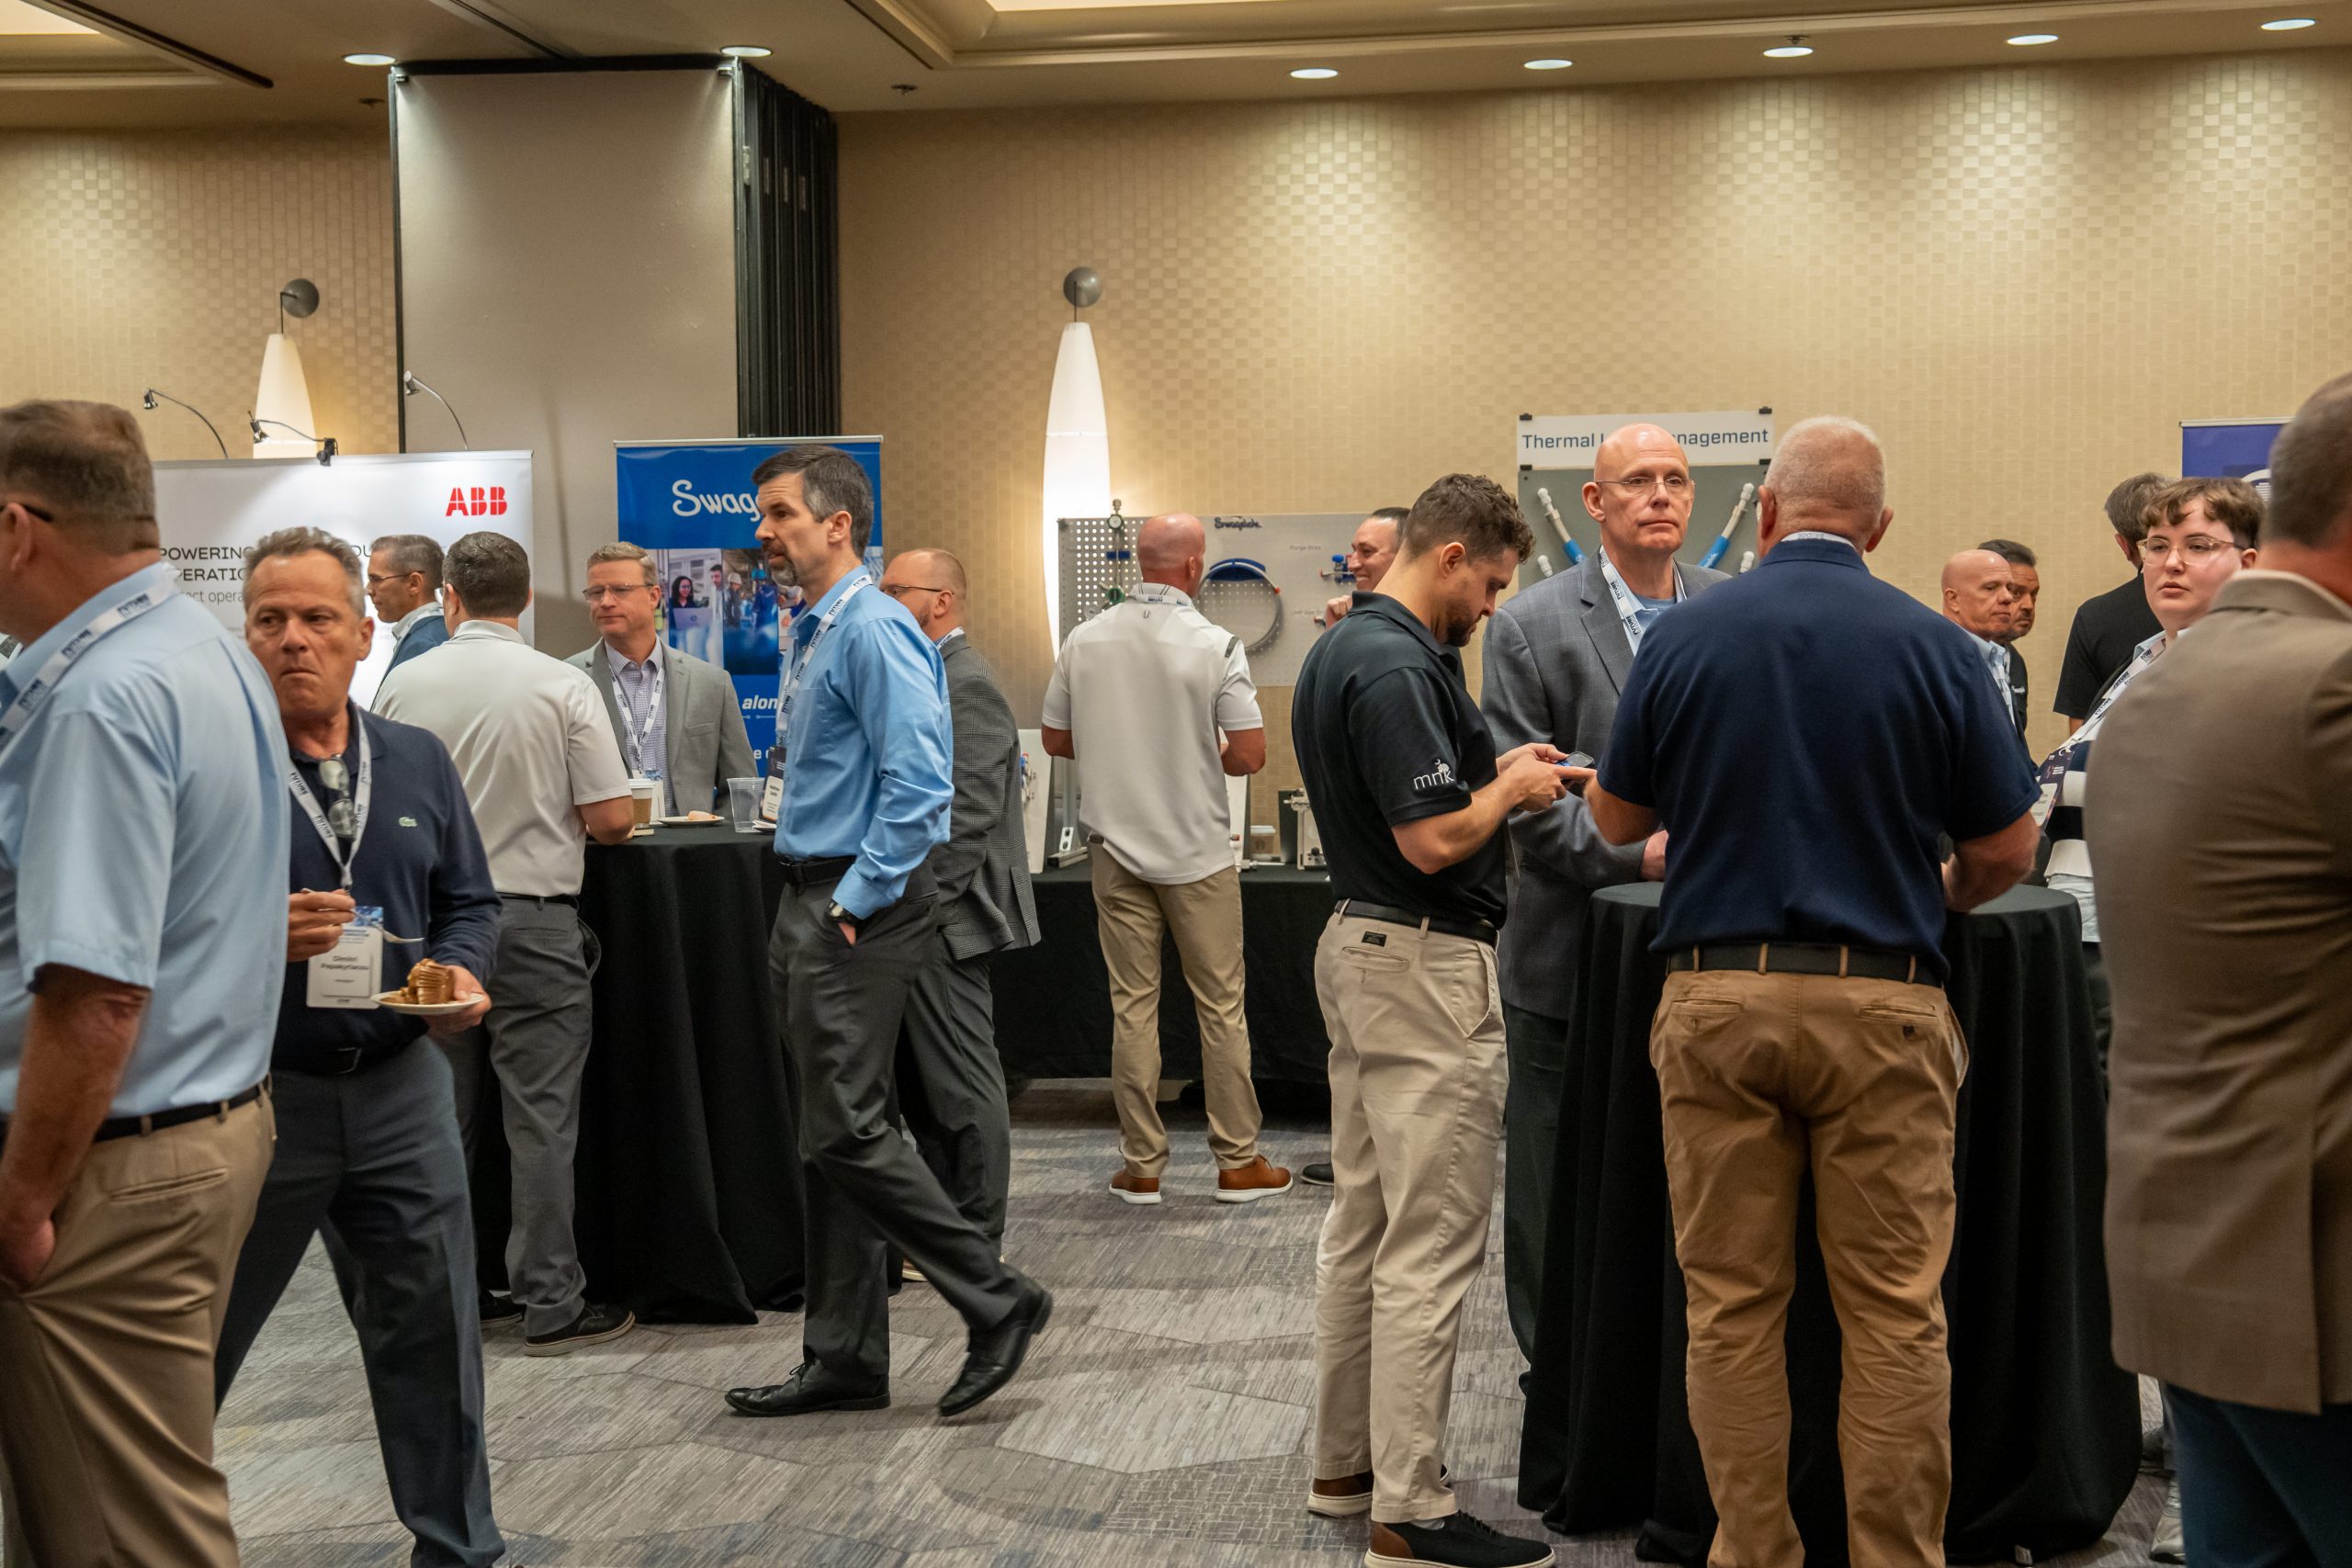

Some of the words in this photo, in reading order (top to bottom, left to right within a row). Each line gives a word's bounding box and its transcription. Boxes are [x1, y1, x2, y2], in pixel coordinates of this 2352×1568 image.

[1521, 433, 1595, 448] Thermal
[1672, 428, 1769, 447] nagement
[446, 487, 507, 516] ABB
[672, 479, 760, 522] Swag
[1610, 581, 1622, 600] FUTURE
[828, 599, 843, 615] FUTURE
[1625, 615, 1638, 636] FUTURE
[810, 629, 822, 648] FUTURE
[795, 662, 806, 681] FUTURE
[289, 772, 309, 795] FUTURE
[1413, 770, 1455, 790] mnk
